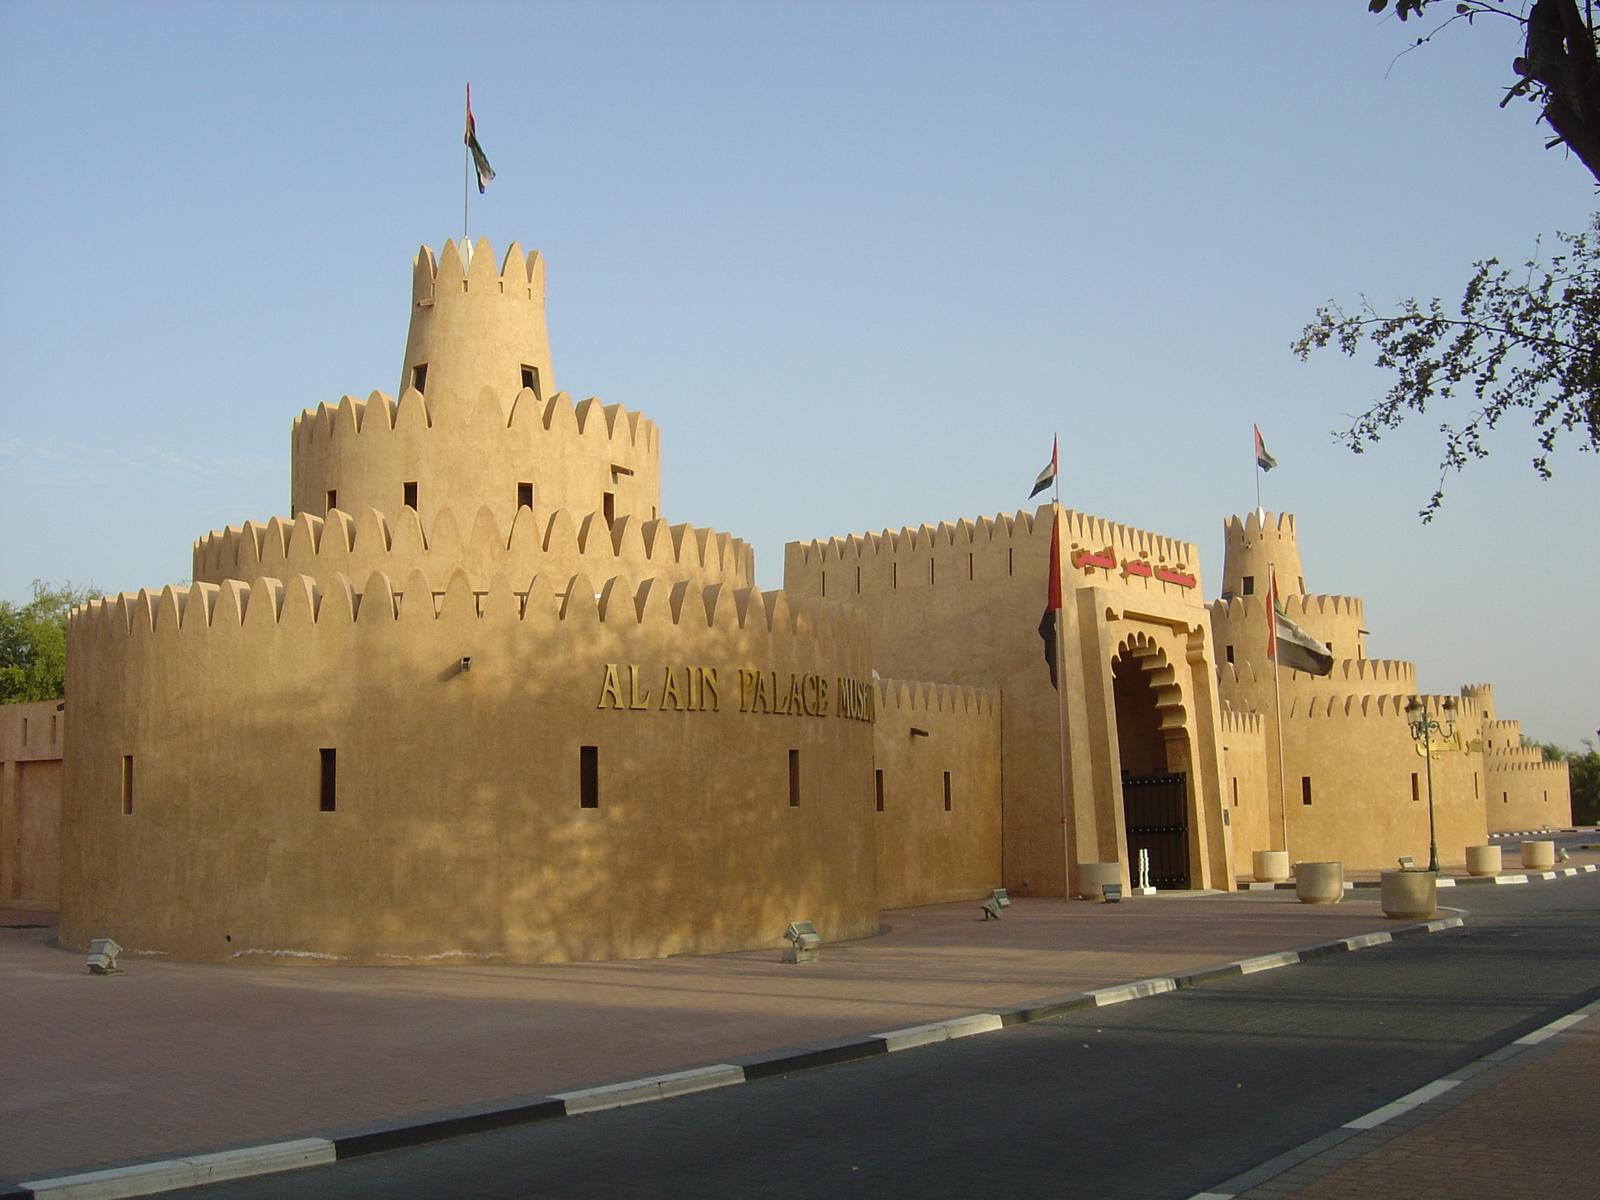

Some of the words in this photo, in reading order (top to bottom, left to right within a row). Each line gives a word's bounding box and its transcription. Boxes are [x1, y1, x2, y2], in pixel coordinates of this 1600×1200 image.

[1070, 543, 1117, 575] العين
[1119, 551, 1153, 579] قصر
[1153, 555, 1197, 589] متحف
[597, 663, 651, 710] AL
[659, 666, 719, 711] AIN
[739, 669, 828, 717] PALACE
[836, 677, 875, 724] MUSE
